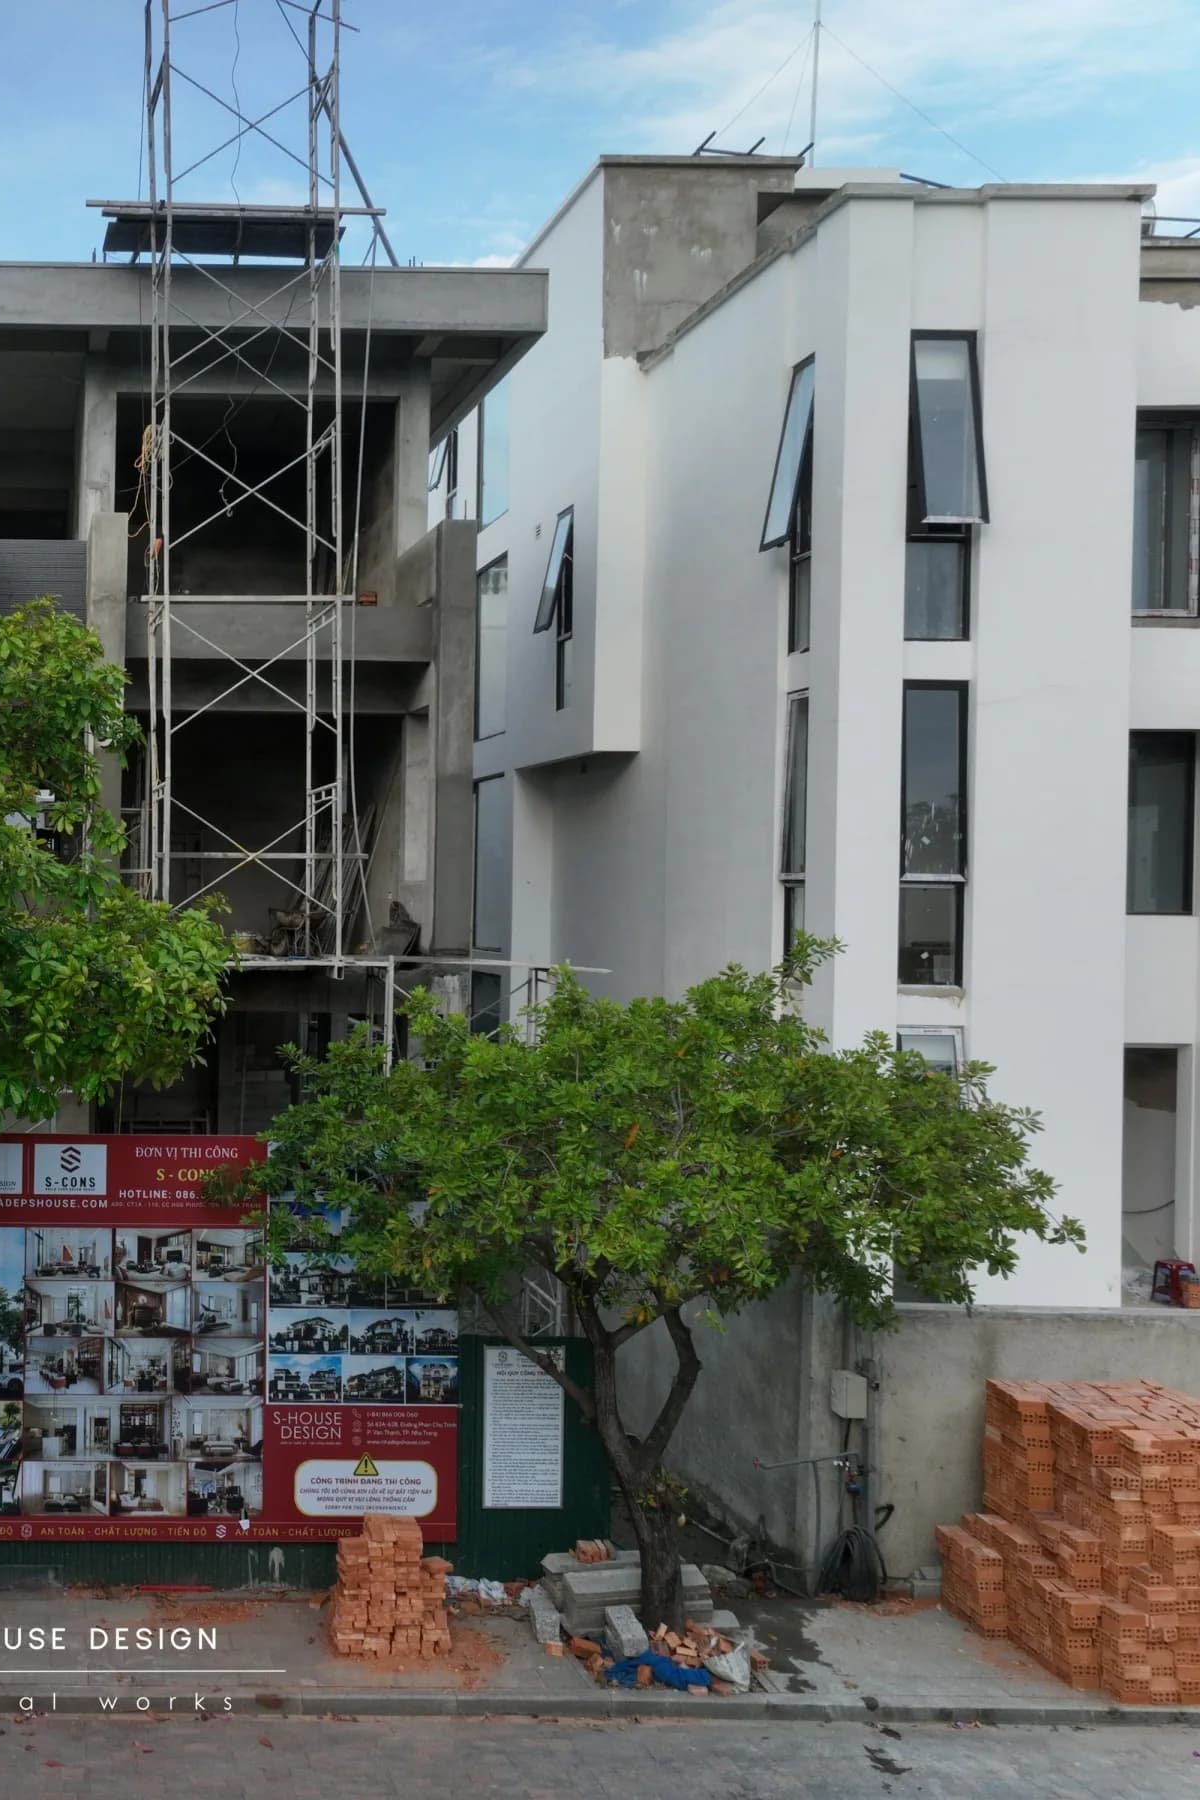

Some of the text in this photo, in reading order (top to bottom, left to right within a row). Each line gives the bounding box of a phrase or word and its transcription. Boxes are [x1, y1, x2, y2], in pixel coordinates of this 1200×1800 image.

[135, 1145, 239, 1160] ĐƠN VỊ THI CÔNG
[156, 1168, 165, 1182] S
[119, 1189, 171, 1200] HOTLINE:
[272, 1411, 342, 1425] S-HOUSE
[281, 1426, 342, 1440] DESIGN
[310, 1477, 332, 1485] CÔNG
[335, 1477, 358, 1485] TRÌNH
[399, 1477, 421, 1485] CÔNG
[40, 1527, 55, 1535] AN
[58, 1526, 84, 1535] TOÀN
[94, 1526, 120, 1536] CHẤT
[253, 1527, 279, 1537] TOÀN
[288, 1527, 315, 1537] CHẤT
